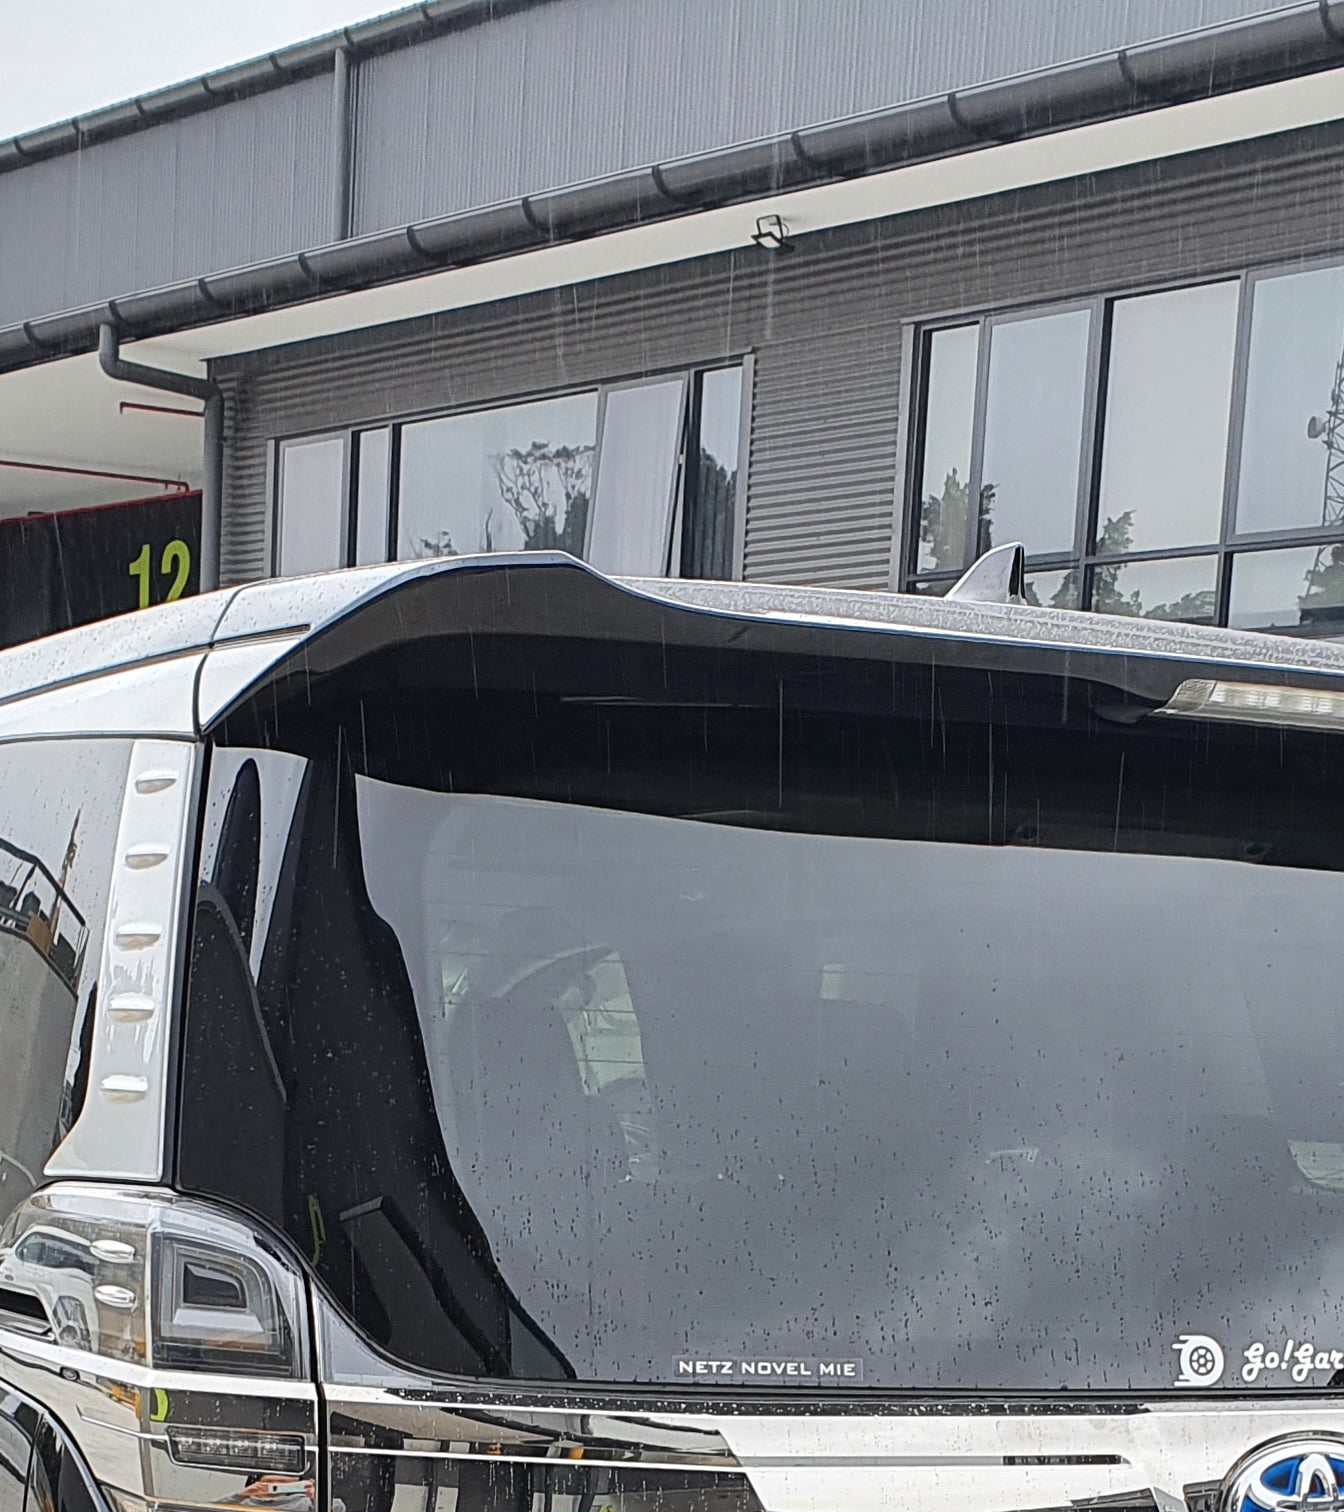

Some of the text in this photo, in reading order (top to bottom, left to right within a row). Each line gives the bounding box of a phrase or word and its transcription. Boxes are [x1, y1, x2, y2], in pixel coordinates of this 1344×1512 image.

[129, 539, 191, 609] 12
[678, 1360, 856, 1376] NETZ NOVEL MIE
